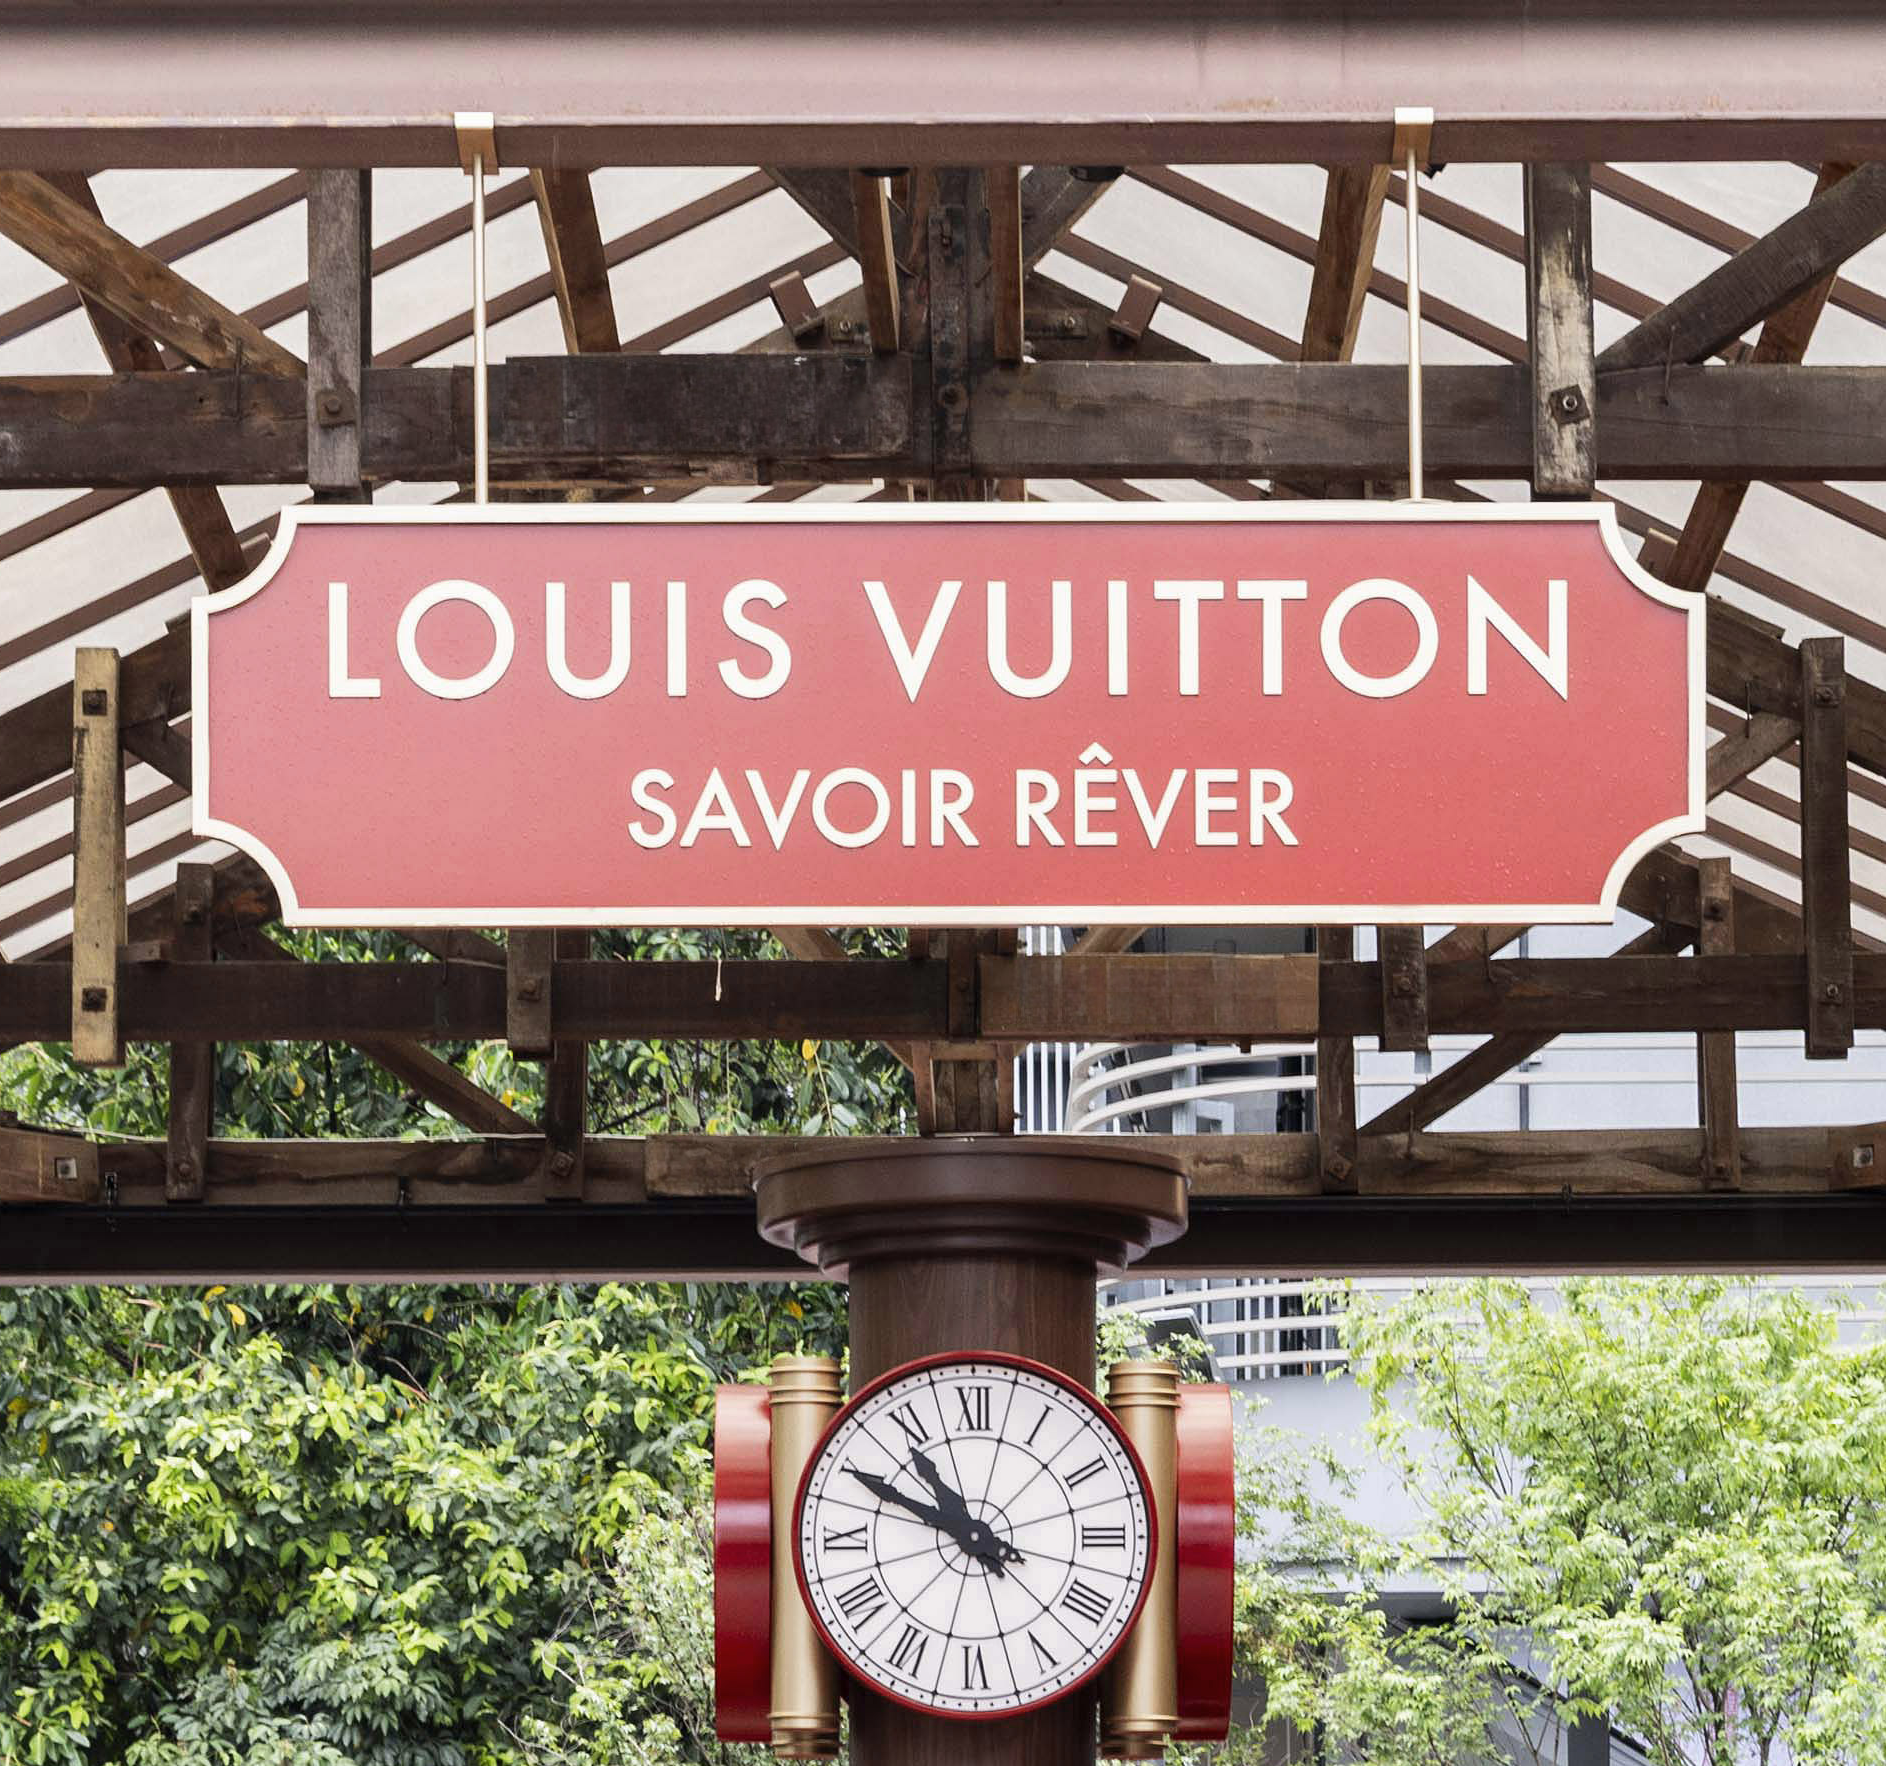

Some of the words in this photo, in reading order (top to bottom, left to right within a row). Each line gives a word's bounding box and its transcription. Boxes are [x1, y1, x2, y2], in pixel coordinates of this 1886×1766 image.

[327, 577, 793, 700] LOUIS
[861, 574, 1569, 704] VUITTON
[627, 766, 981, 852] SAVOIR
[1014, 741, 1300, 850] RÊVER
[886, 1400, 933, 1452] XI
[954, 1385, 993, 1432] XII
[1063, 1454, 1109, 1491] II
[1081, 1523, 1127, 1552] III
[833, 1573, 889, 1634] VIII
[885, 1622, 930, 1679] VII
[961, 1643, 992, 1691] VI
[1027, 1628, 1061, 1676] V
